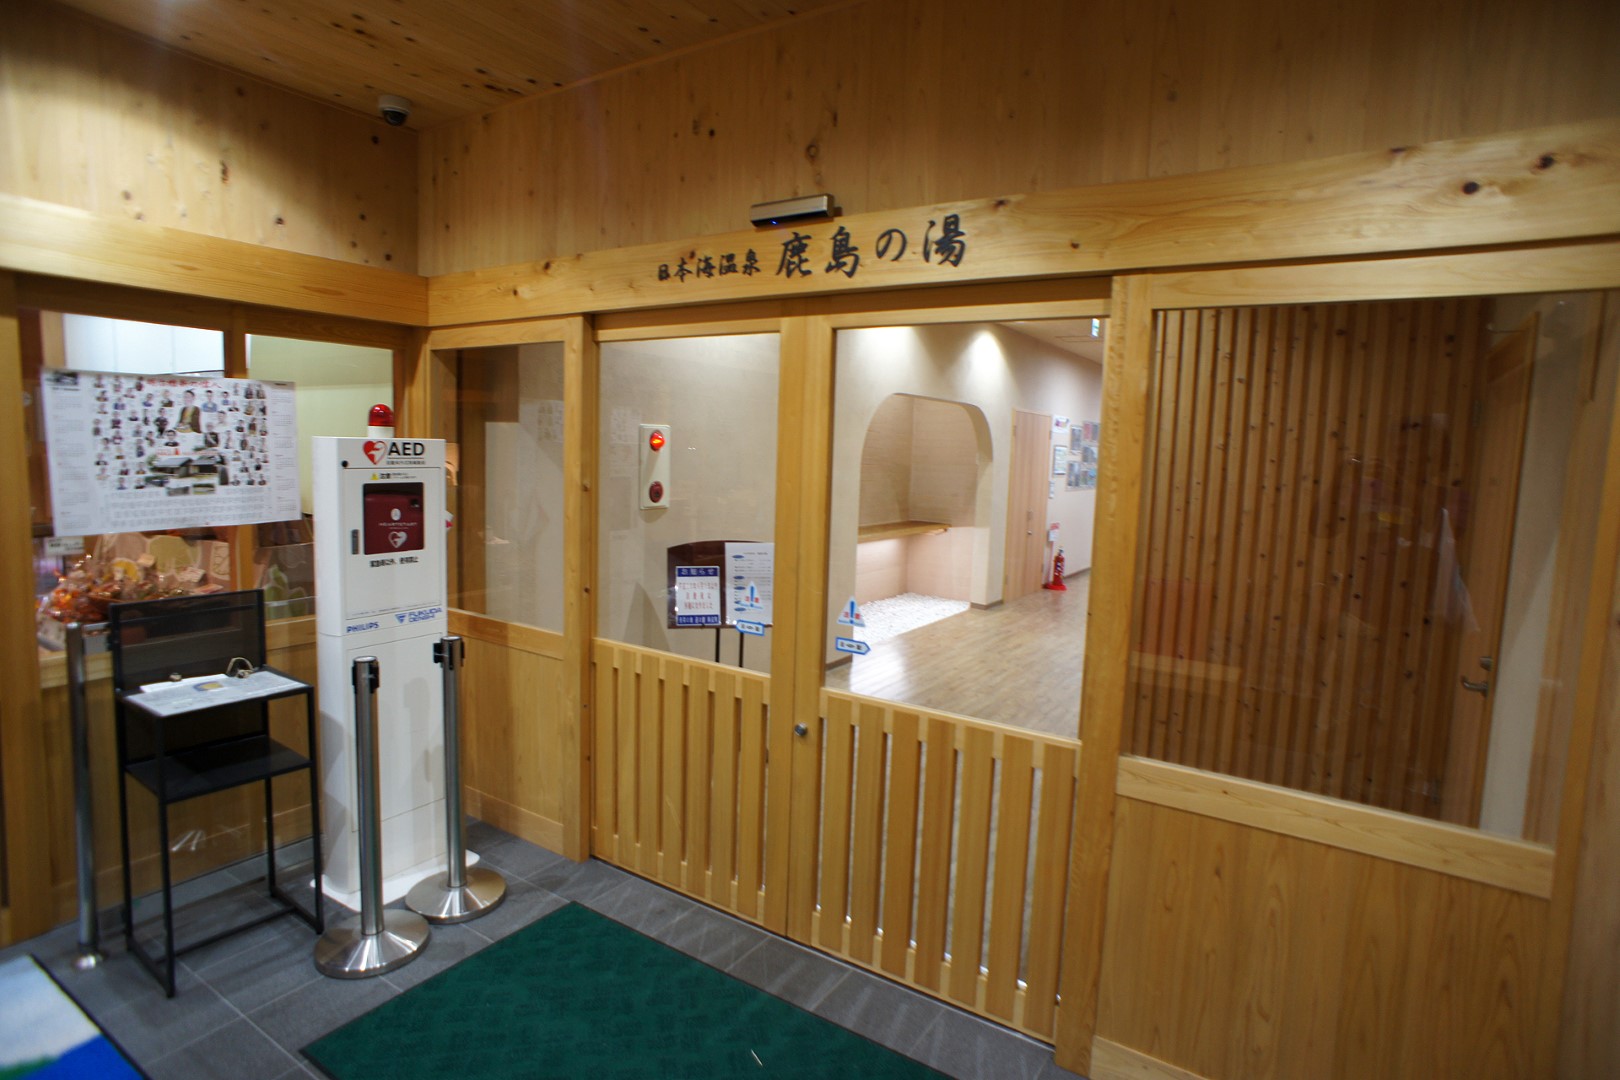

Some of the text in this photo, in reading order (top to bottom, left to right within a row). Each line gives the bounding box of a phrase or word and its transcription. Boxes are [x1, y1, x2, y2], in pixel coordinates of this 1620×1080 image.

[658, 214, 967, 283] 日本海温泉 鹿島の湯
[388, 441, 425, 456] AED
[408, 607, 443, 618] FUKUDA
[346, 621, 380, 633] PHILIPS
